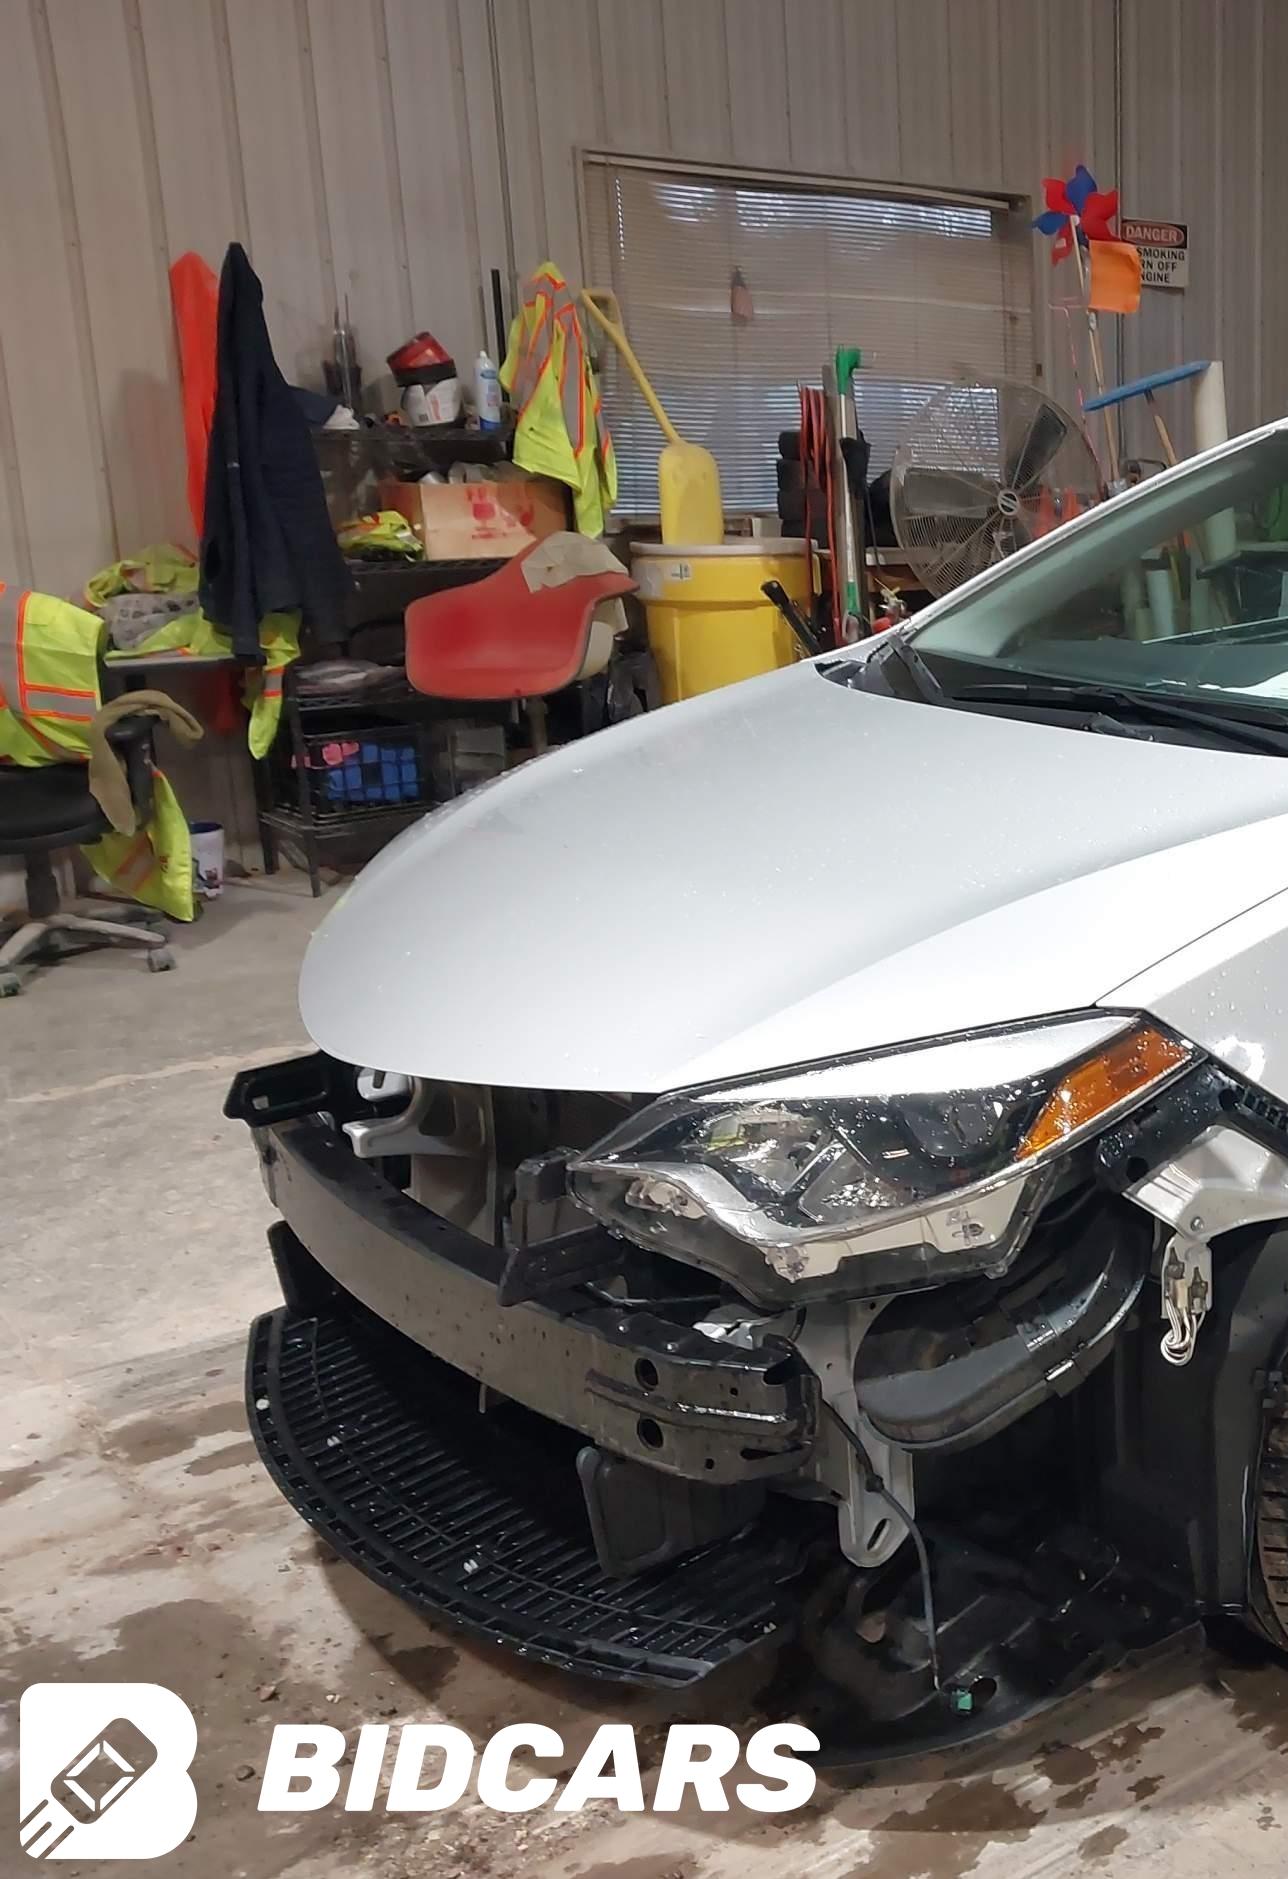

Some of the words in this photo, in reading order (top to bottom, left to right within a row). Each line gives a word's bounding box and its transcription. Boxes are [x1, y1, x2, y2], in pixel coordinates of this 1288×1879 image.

[1126, 225, 1178, 242] DANGER
[1136, 247, 1184, 261] SMOKING
[1157, 261, 1177, 272] OFF
[1141, 271, 1170, 283] NGINE
